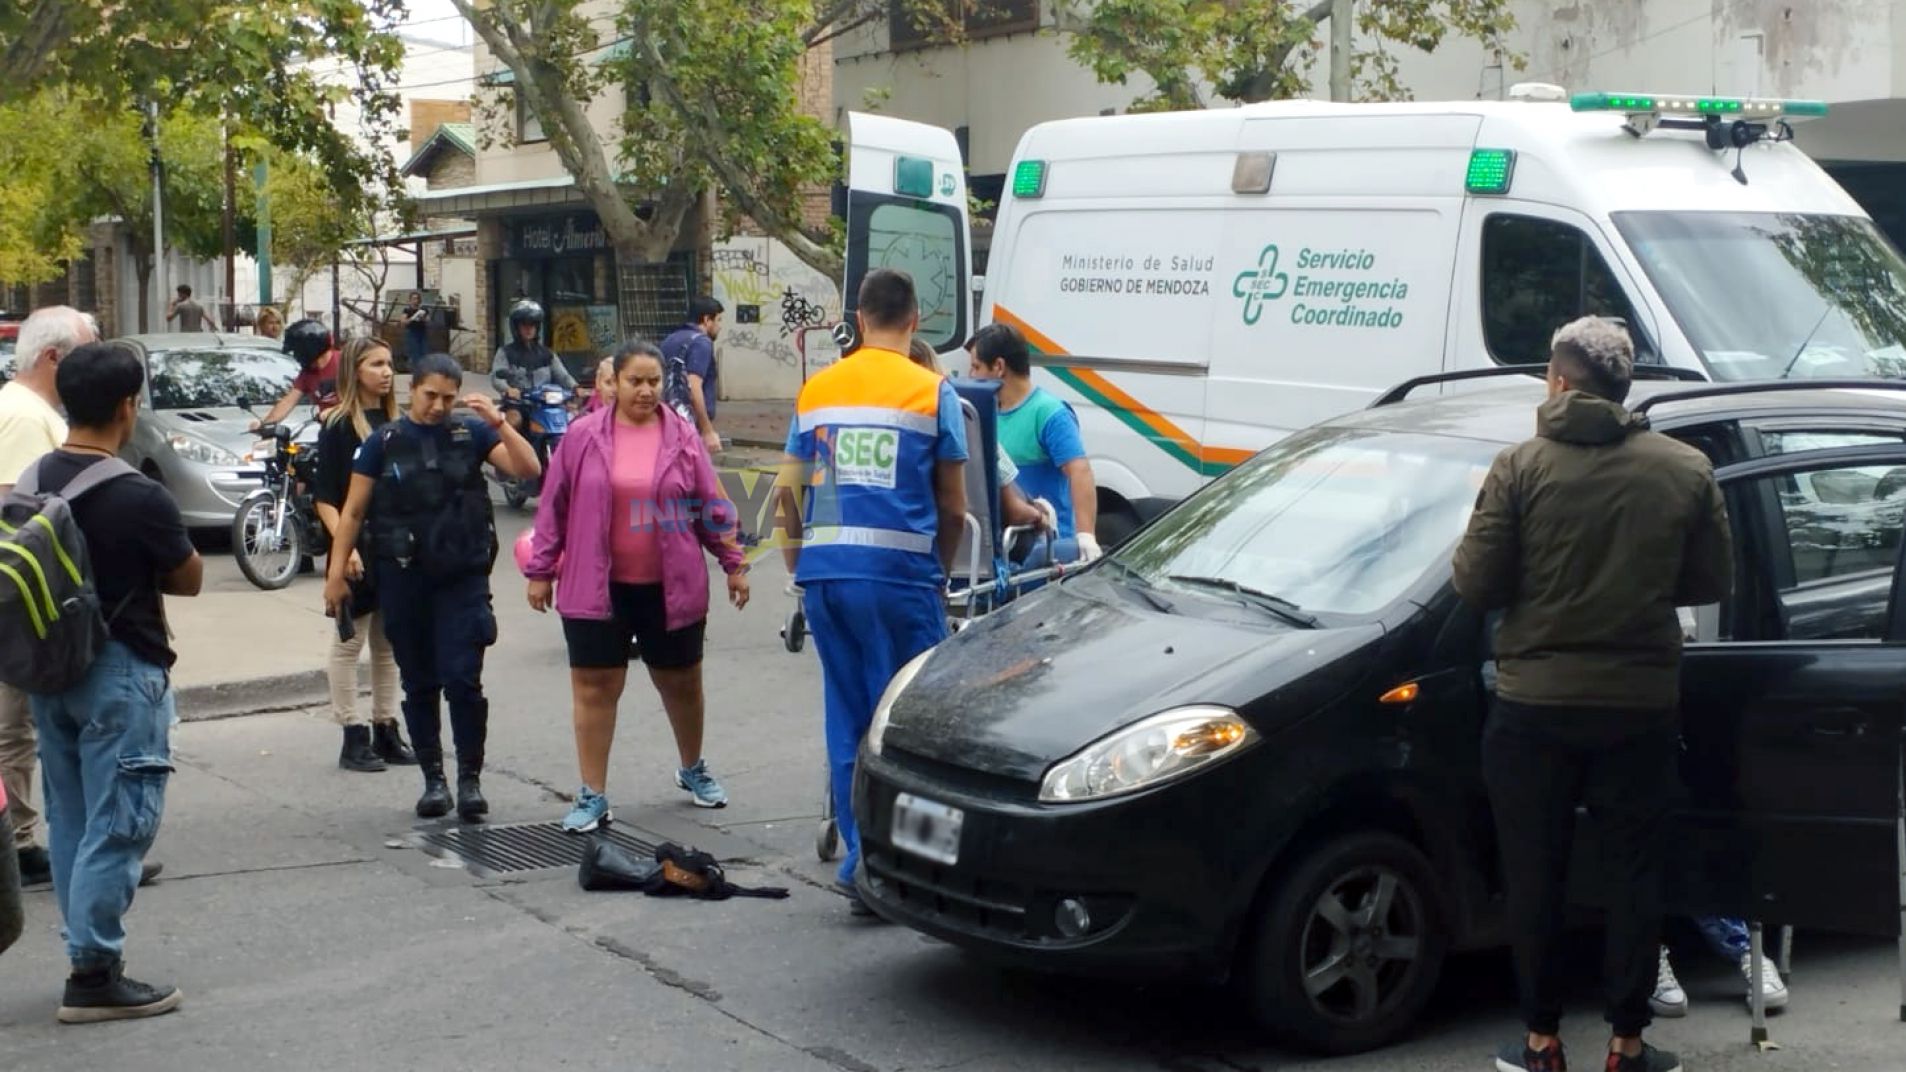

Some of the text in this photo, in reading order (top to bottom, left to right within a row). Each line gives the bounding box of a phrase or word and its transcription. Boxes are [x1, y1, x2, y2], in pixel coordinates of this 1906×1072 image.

[523, 224, 551, 250] Hotel
[1062, 254, 1215, 272] Ministerio de Salud
[1297, 247, 1375, 270] Servicio
[1060, 277, 1210, 296] GOBIERNO DE MENDOZA
[1250, 279, 1271, 290] SEC
[1293, 276, 1408, 303] Emergencia
[1291, 303, 1403, 328] Coordinado
[837, 431, 895, 469] SEC
